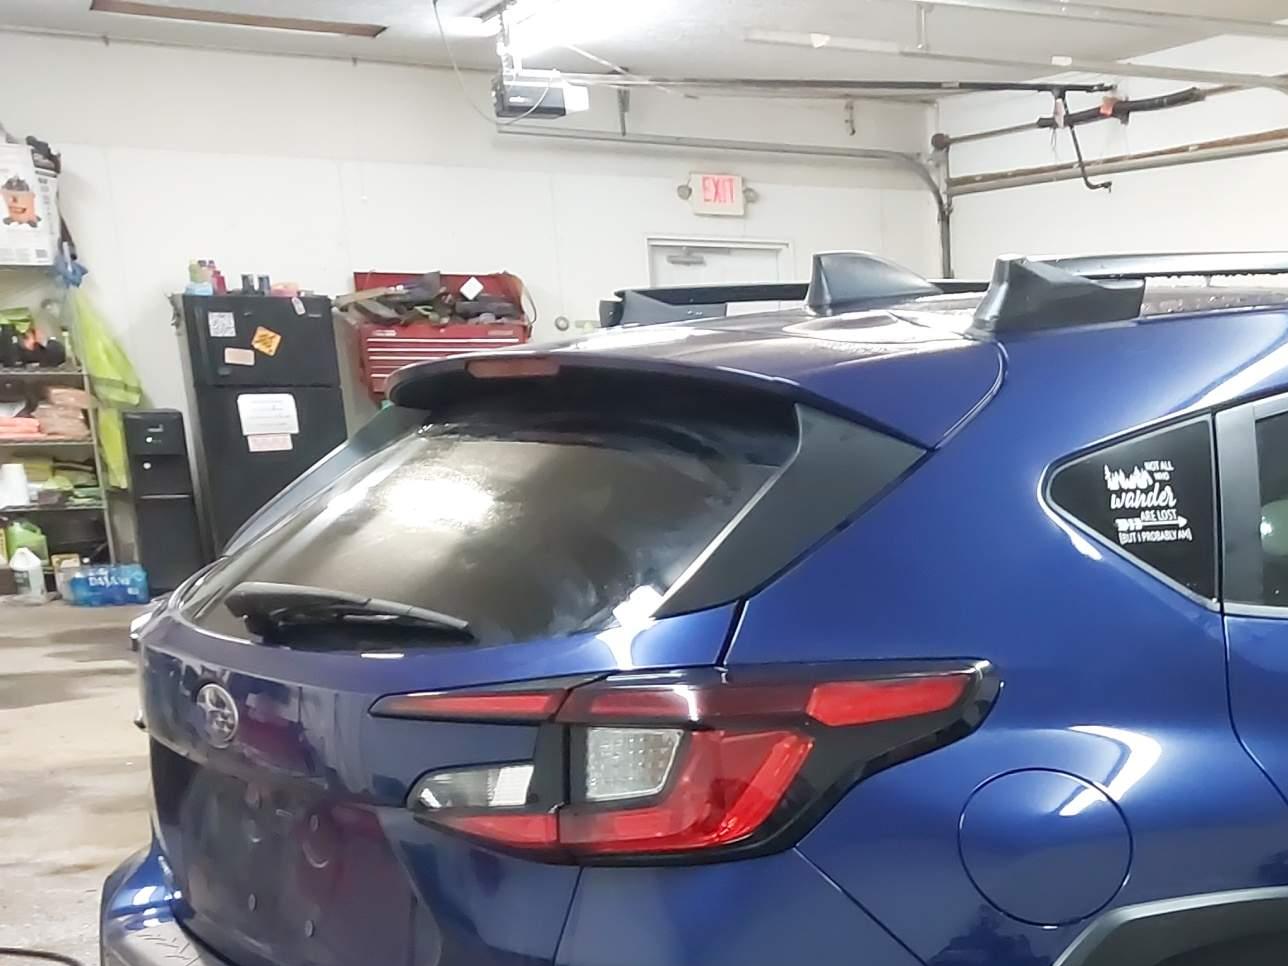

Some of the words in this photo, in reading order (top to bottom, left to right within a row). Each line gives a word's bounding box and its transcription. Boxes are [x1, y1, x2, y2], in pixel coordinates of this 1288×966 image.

[702, 176, 734, 203] EXIT
[1144, 461, 1159, 471] NOT
[1160, 460, 1174, 471] ALL
[1153, 472, 1170, 481] WHO
[1110, 482, 1177, 509] wander
[1141, 510, 1157, 521] ARE
[1157, 509, 1177, 521] LOST
[1142, 530, 1177, 542] PROBABLY
